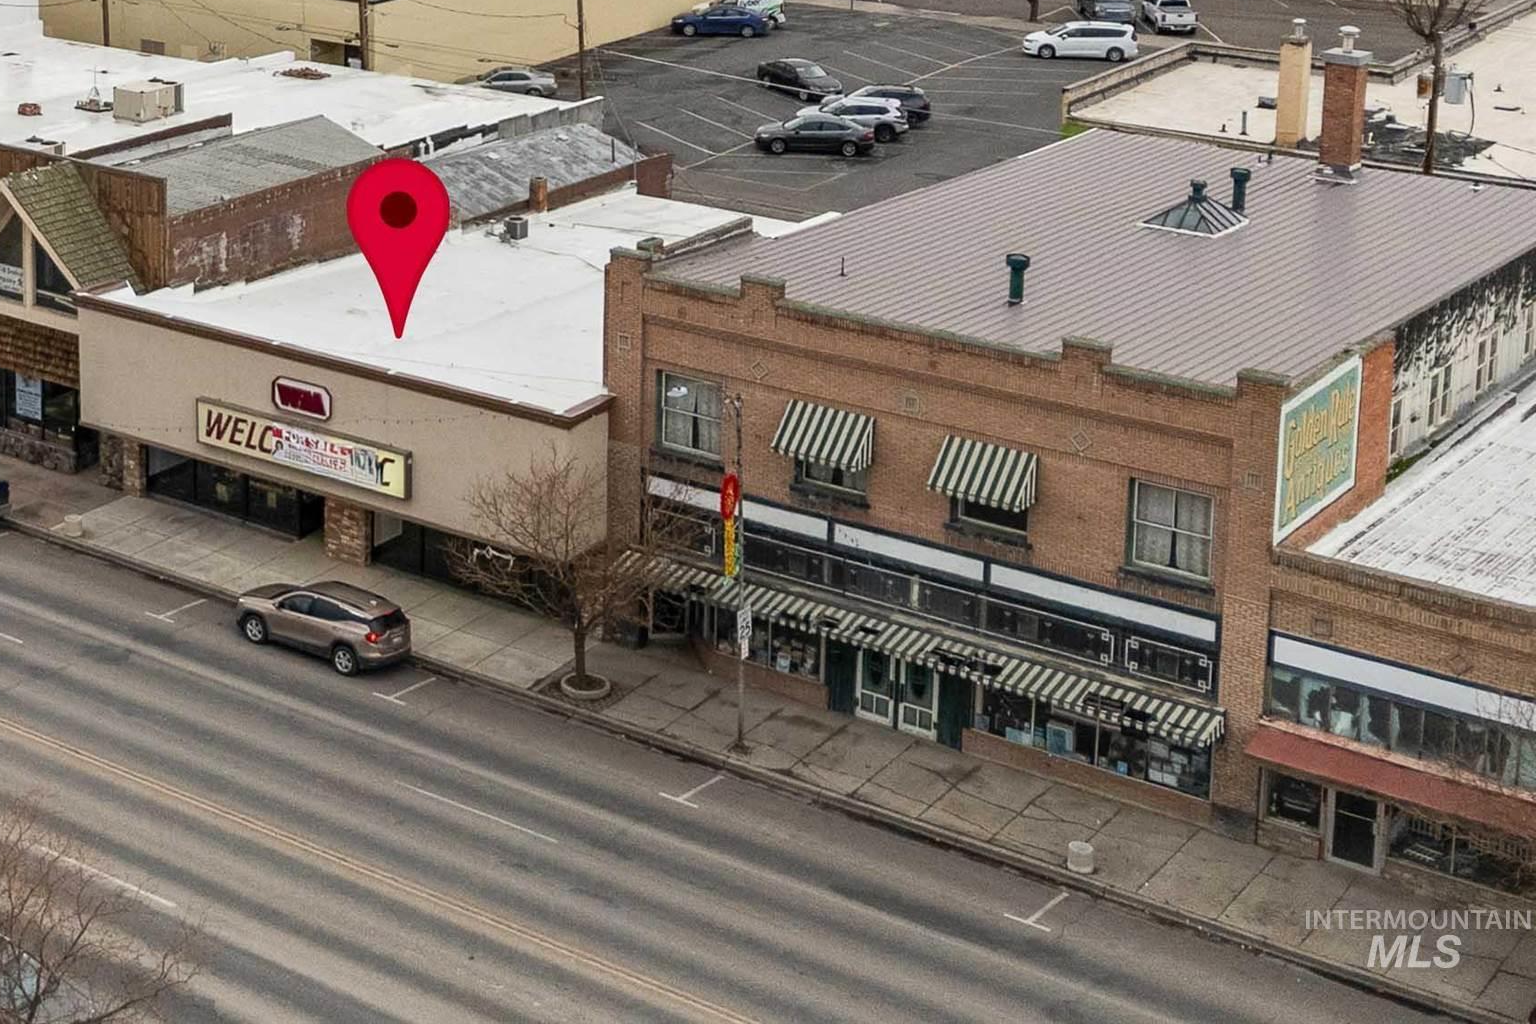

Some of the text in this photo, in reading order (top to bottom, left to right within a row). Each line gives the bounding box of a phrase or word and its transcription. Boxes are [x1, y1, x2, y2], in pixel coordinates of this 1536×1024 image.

[205, 409, 273, 454] WELC
[1284, 380, 1356, 480] Golden Rule
[1281, 443, 1351, 527] Antiques
[739, 621, 751, 640] 25
